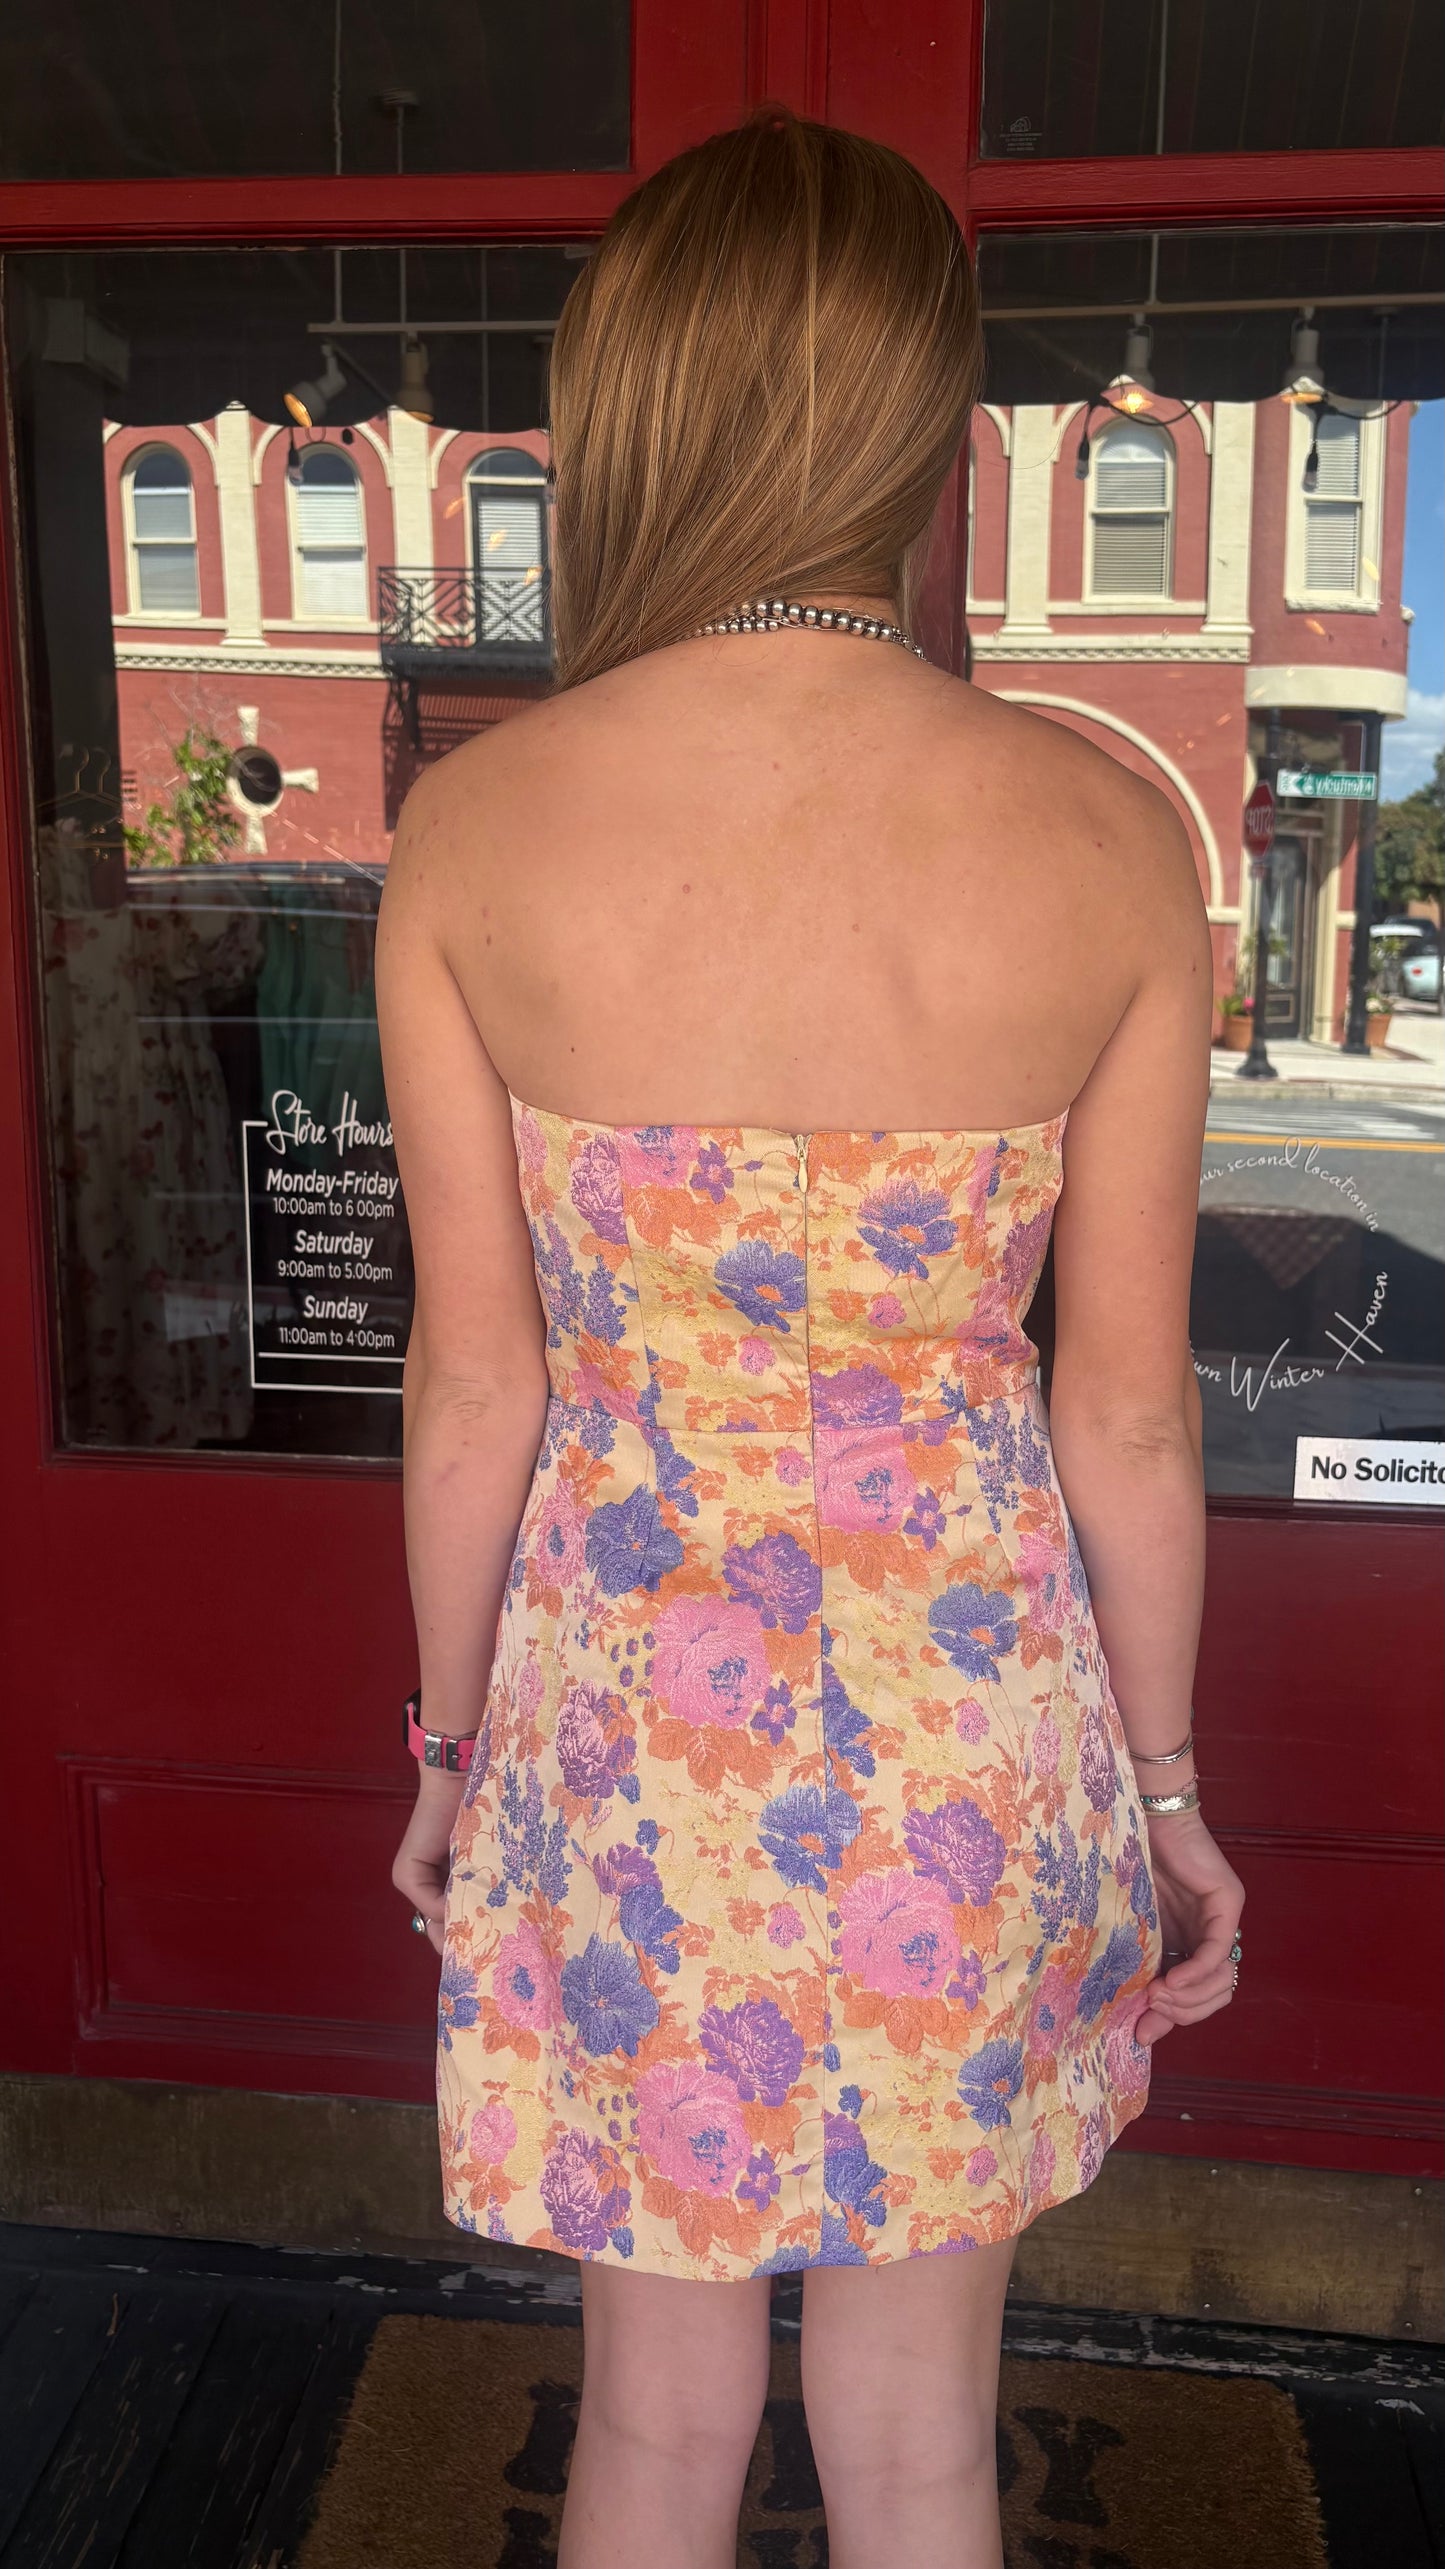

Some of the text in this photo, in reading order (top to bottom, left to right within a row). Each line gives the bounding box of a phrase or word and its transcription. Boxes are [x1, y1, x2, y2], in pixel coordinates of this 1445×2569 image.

[266, 1089, 394, 1156] Store Hours
[266, 1168, 399, 1199] Monday-Friday
[1200, 1136, 1380, 1232] ur second location in
[273, 1197, 395, 1220] 10:00am to 600pm
[294, 1230, 374, 1259] Saturday
[278, 1262, 325, 1280] 9:00am
[328, 1262, 342, 1279] to
[303, 1296, 368, 1324] Sunday
[279, 1327, 327, 1347] 11:00am
[330, 1329, 344, 1347] to
[1230, 1337, 1325, 1412] Winter
[1325, 1271, 1389, 1372] Haven
[1311, 1455, 1347, 1480] No
